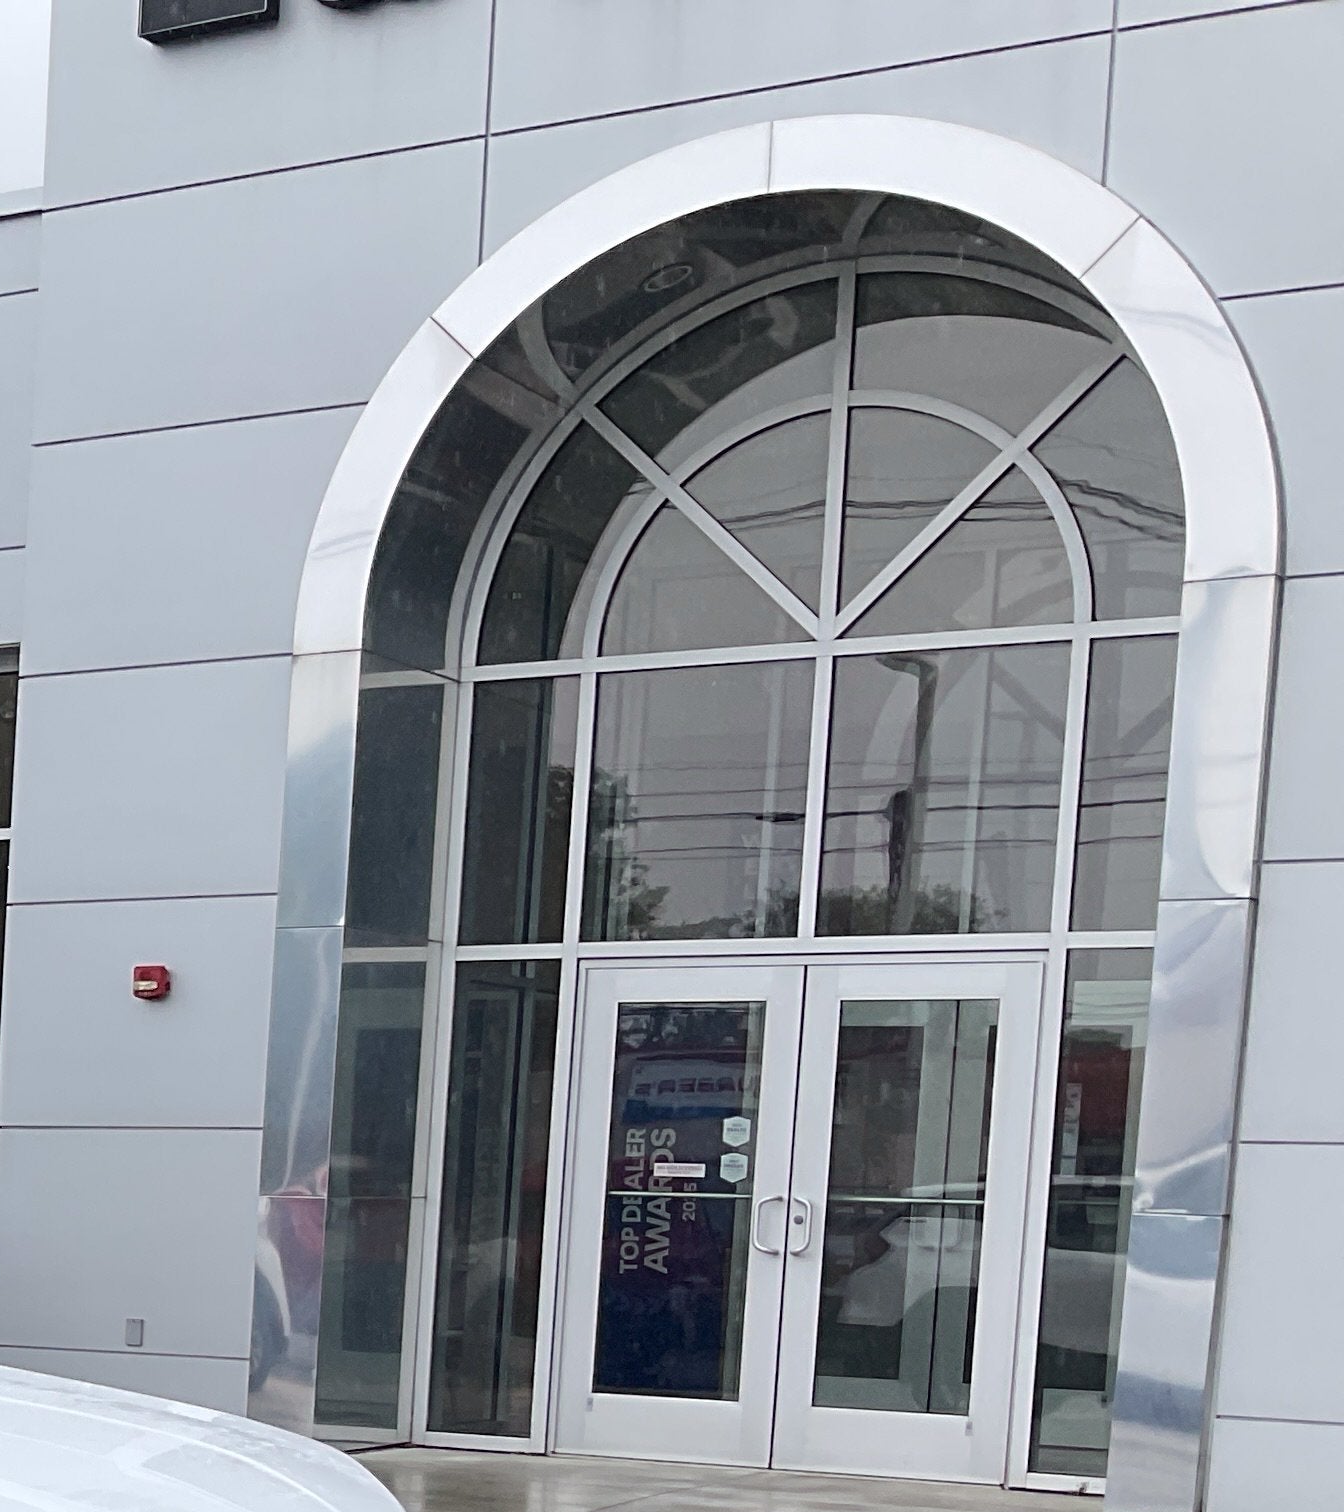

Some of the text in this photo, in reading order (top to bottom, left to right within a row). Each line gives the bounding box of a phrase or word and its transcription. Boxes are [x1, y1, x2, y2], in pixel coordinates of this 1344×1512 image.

[619, 1128, 646, 1274] TOP DEALER
[643, 1128, 676, 1274] AWARDS
